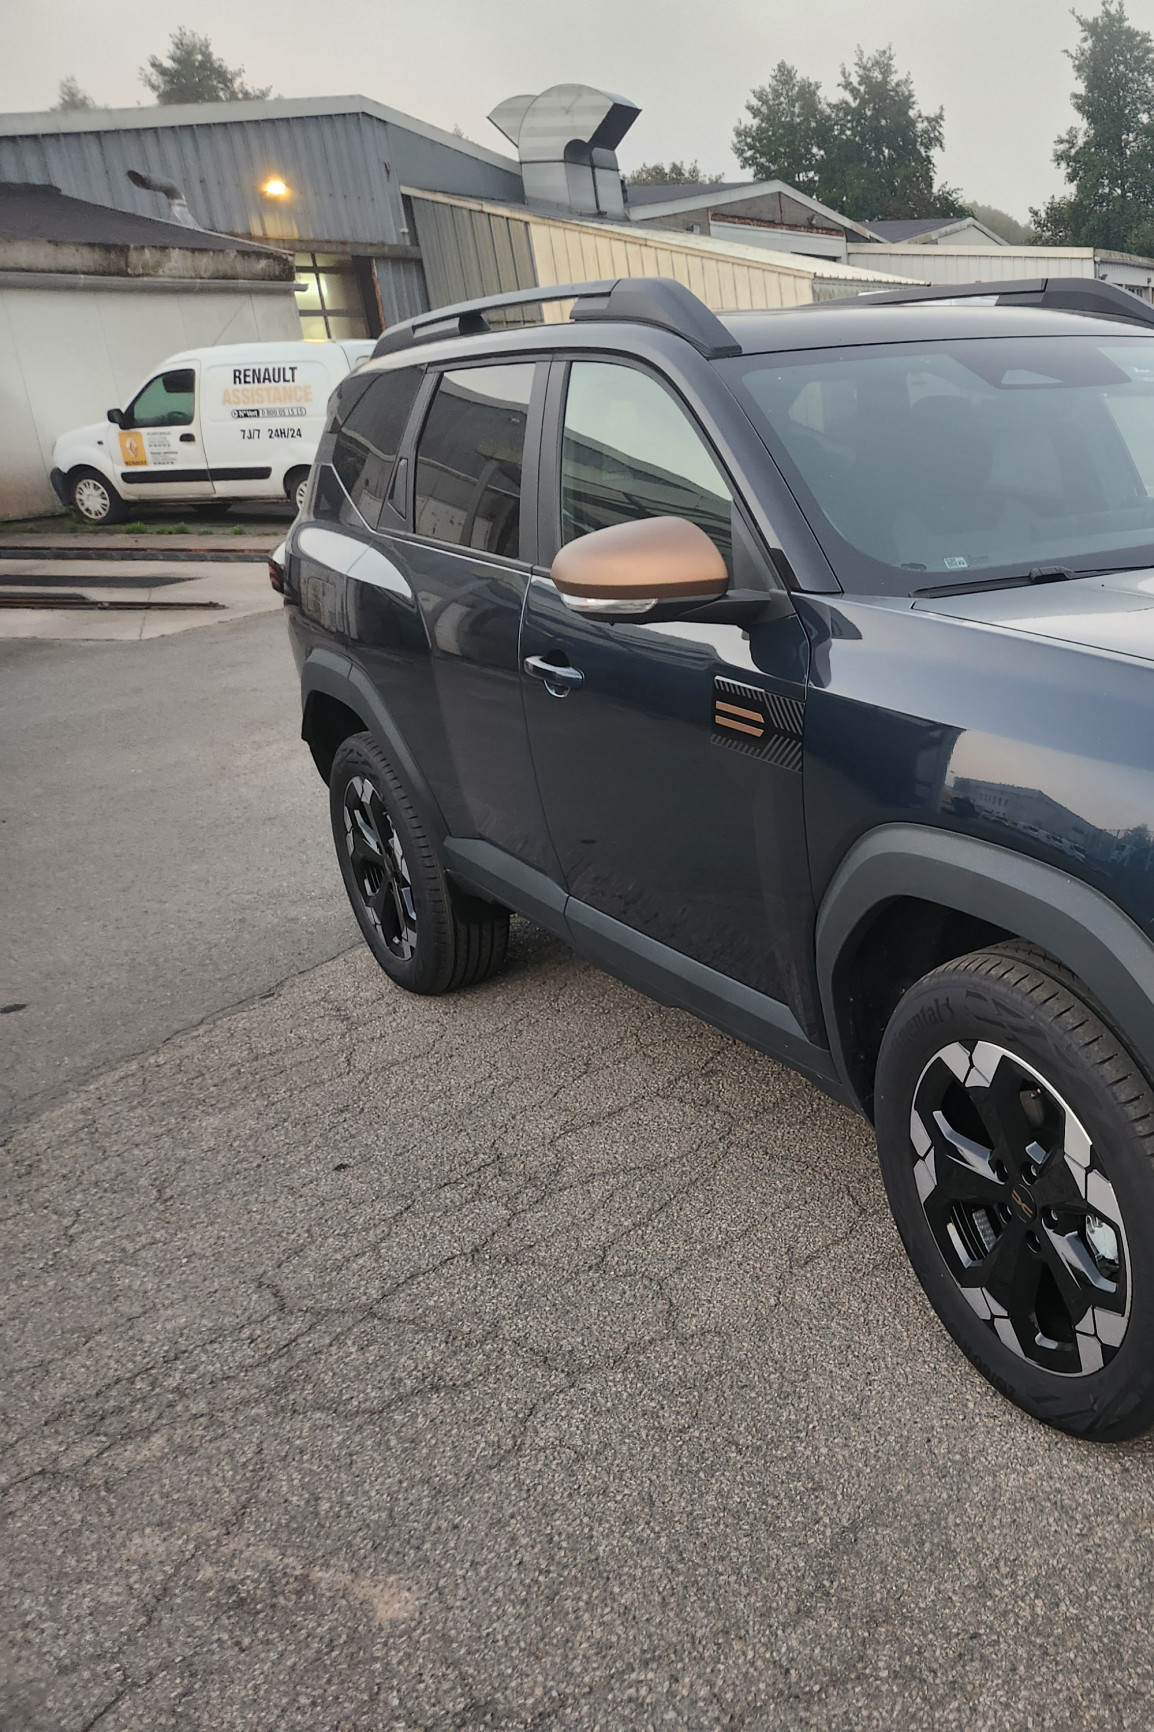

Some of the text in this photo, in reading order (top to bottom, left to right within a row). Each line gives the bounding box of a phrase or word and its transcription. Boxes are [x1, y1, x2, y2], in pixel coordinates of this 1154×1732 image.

[233, 366, 298, 385] RENAULT
[222, 385, 312, 405] ASSISTANCE
[240, 427, 302, 440] 7J/7 24H/24
